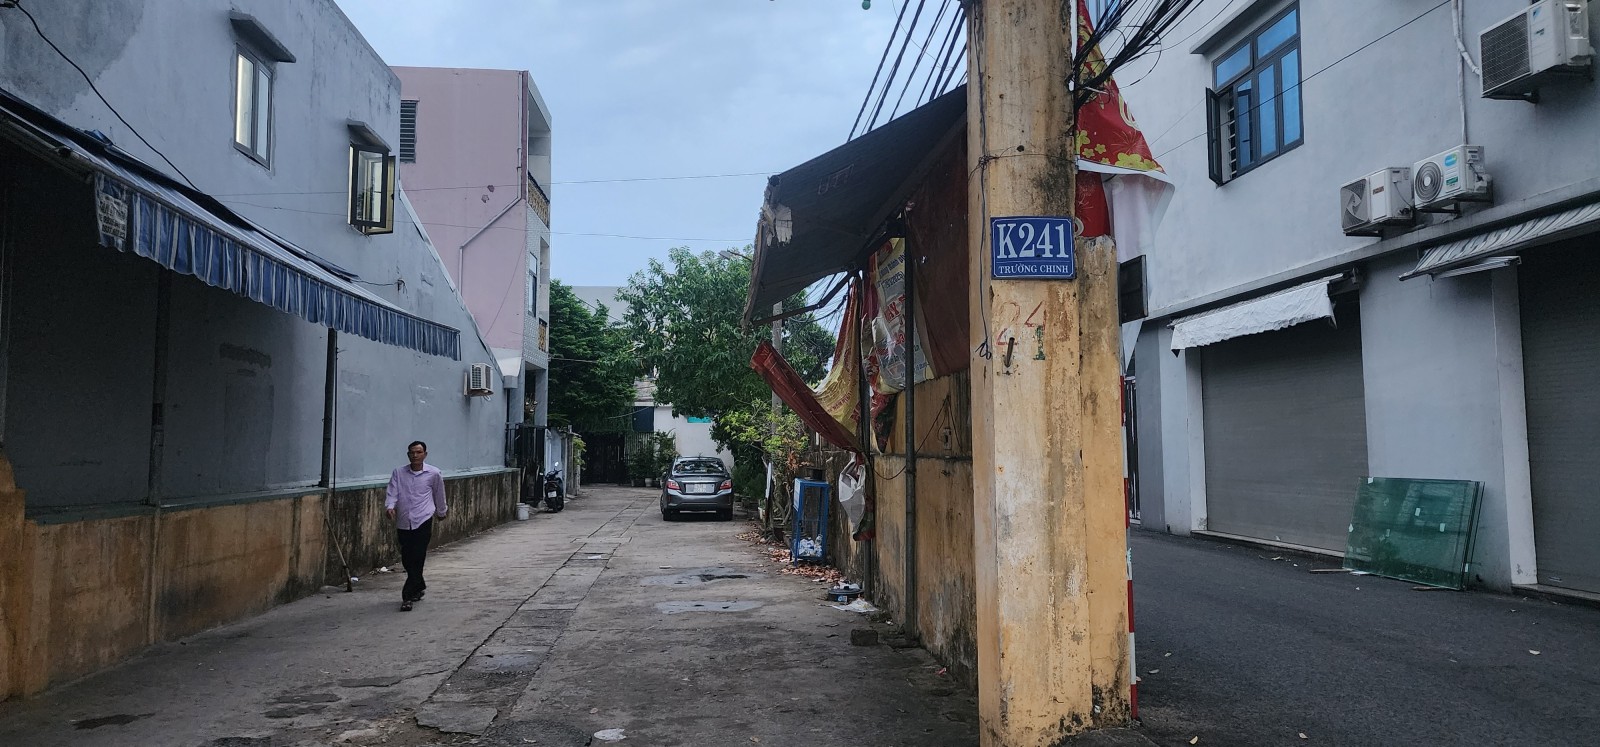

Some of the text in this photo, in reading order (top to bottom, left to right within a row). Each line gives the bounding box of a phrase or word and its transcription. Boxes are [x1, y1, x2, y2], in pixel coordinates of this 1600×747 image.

[996, 222, 1069, 259] K241
[1000, 263, 1069, 274] TRƯỜNG CHINH
